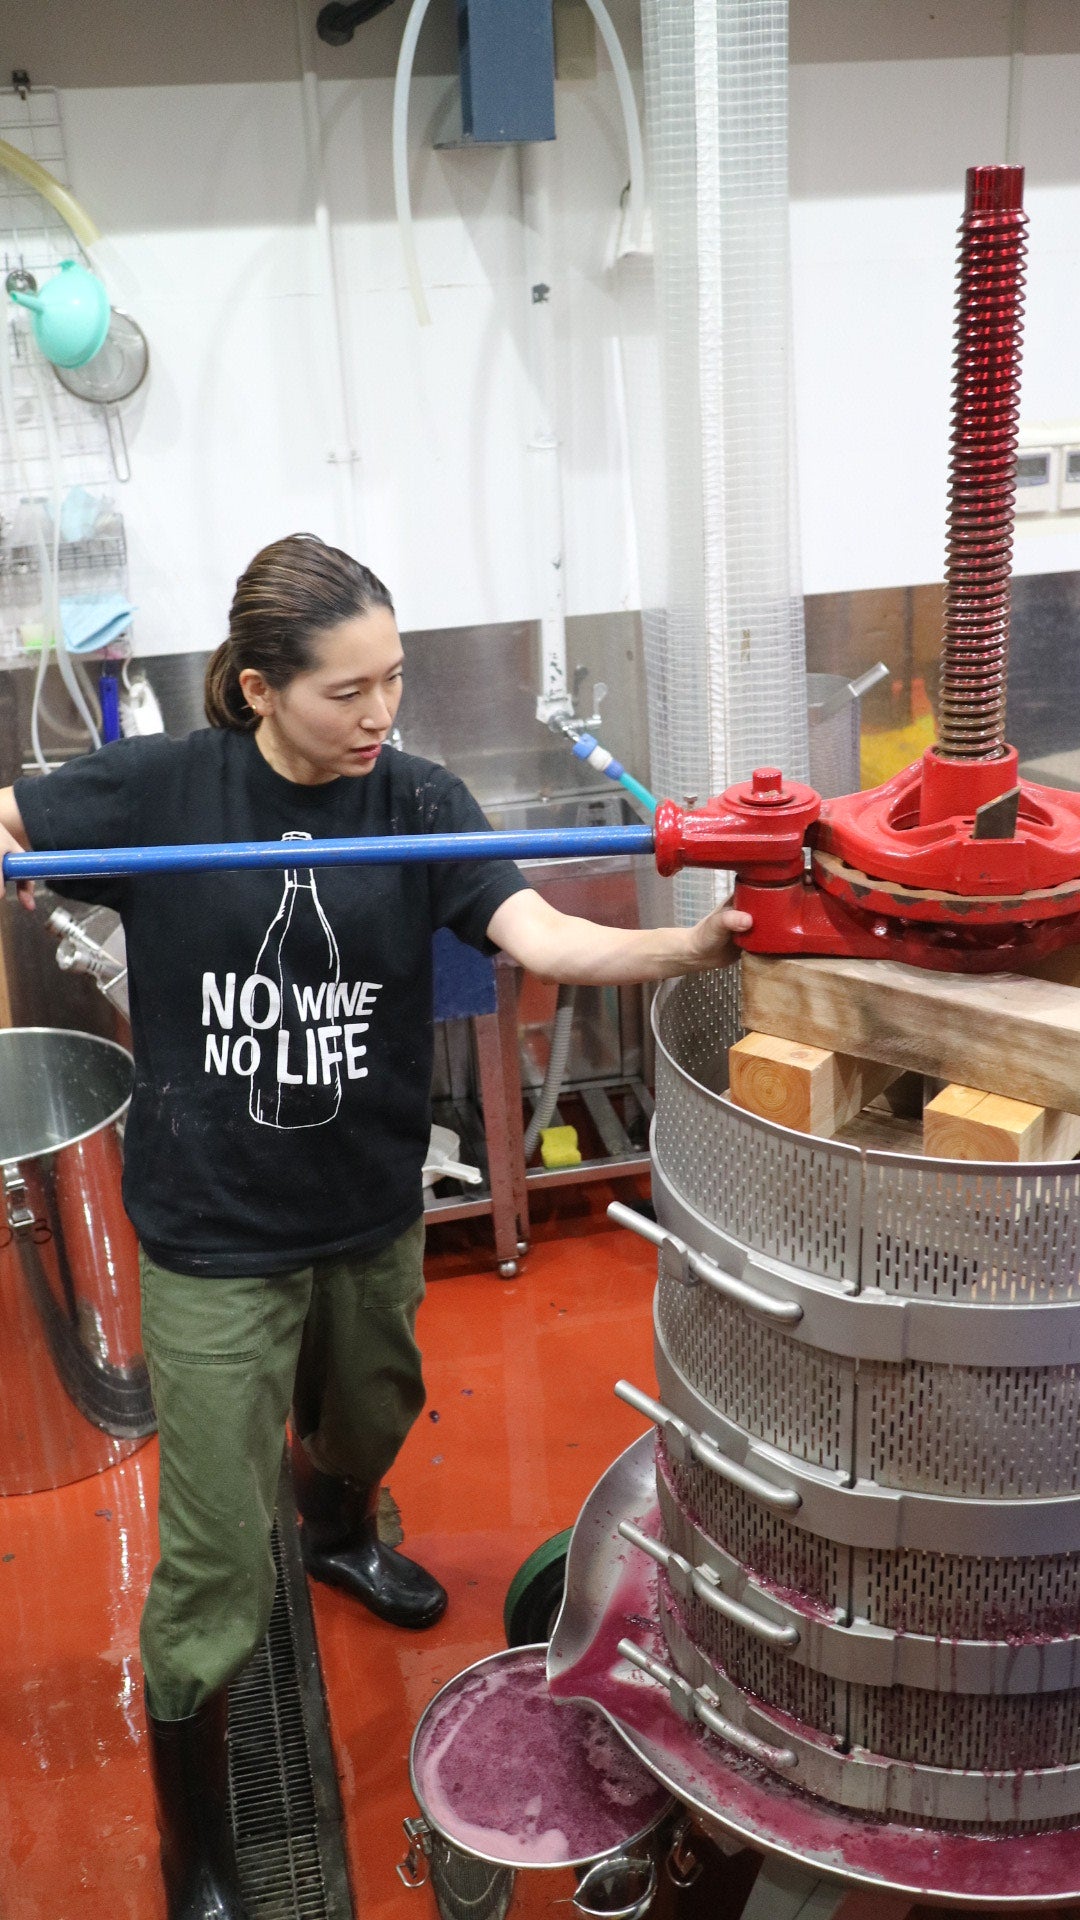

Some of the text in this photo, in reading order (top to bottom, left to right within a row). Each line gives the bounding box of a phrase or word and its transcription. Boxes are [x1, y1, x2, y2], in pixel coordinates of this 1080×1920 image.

[202, 972, 383, 1029] NO WINE
[204, 1022, 370, 1085] NO LIFE
